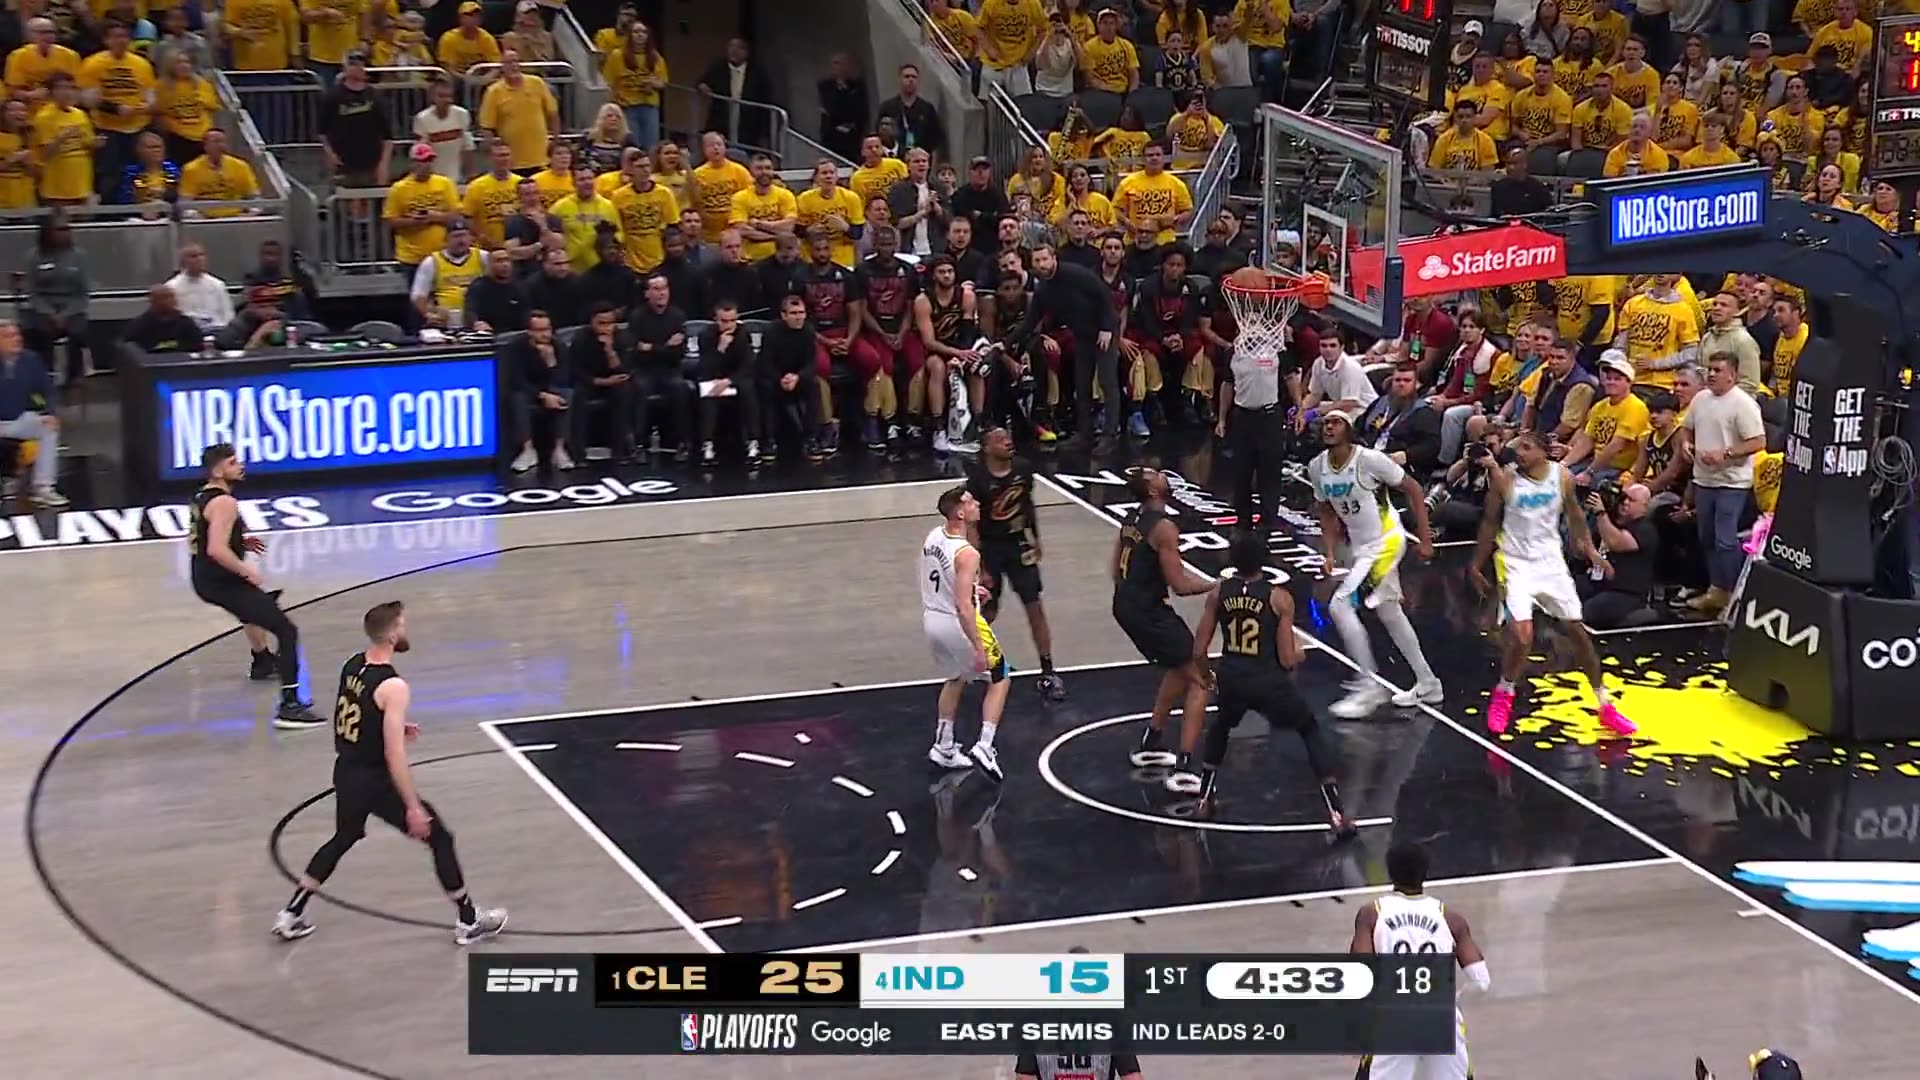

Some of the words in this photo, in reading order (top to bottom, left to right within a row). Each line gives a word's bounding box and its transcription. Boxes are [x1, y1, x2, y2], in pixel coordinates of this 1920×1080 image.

[1617, 189, 1759, 240] NBAStore.com
[1795, 380, 1815, 410] GET
[1834, 388, 1866, 416] GET
[170, 384, 483, 469] NBAStore.com
[1793, 408, 1813, 439] THE
[1833, 416, 1864, 443] THE
[1793, 440, 1813, 475] App
[1837, 445, 1868, 478] App
[371, 477, 680, 514] Google
[1342, 500, 1361, 515] 33
[0, 496, 330, 548] LAYOFS
[1771, 535, 1813, 570] Google
[929, 569, 940, 593] 9
[1223, 596, 1264, 614] HUNTER
[1227, 617, 1260, 656] 12
[336, 695, 361, 743] 32
